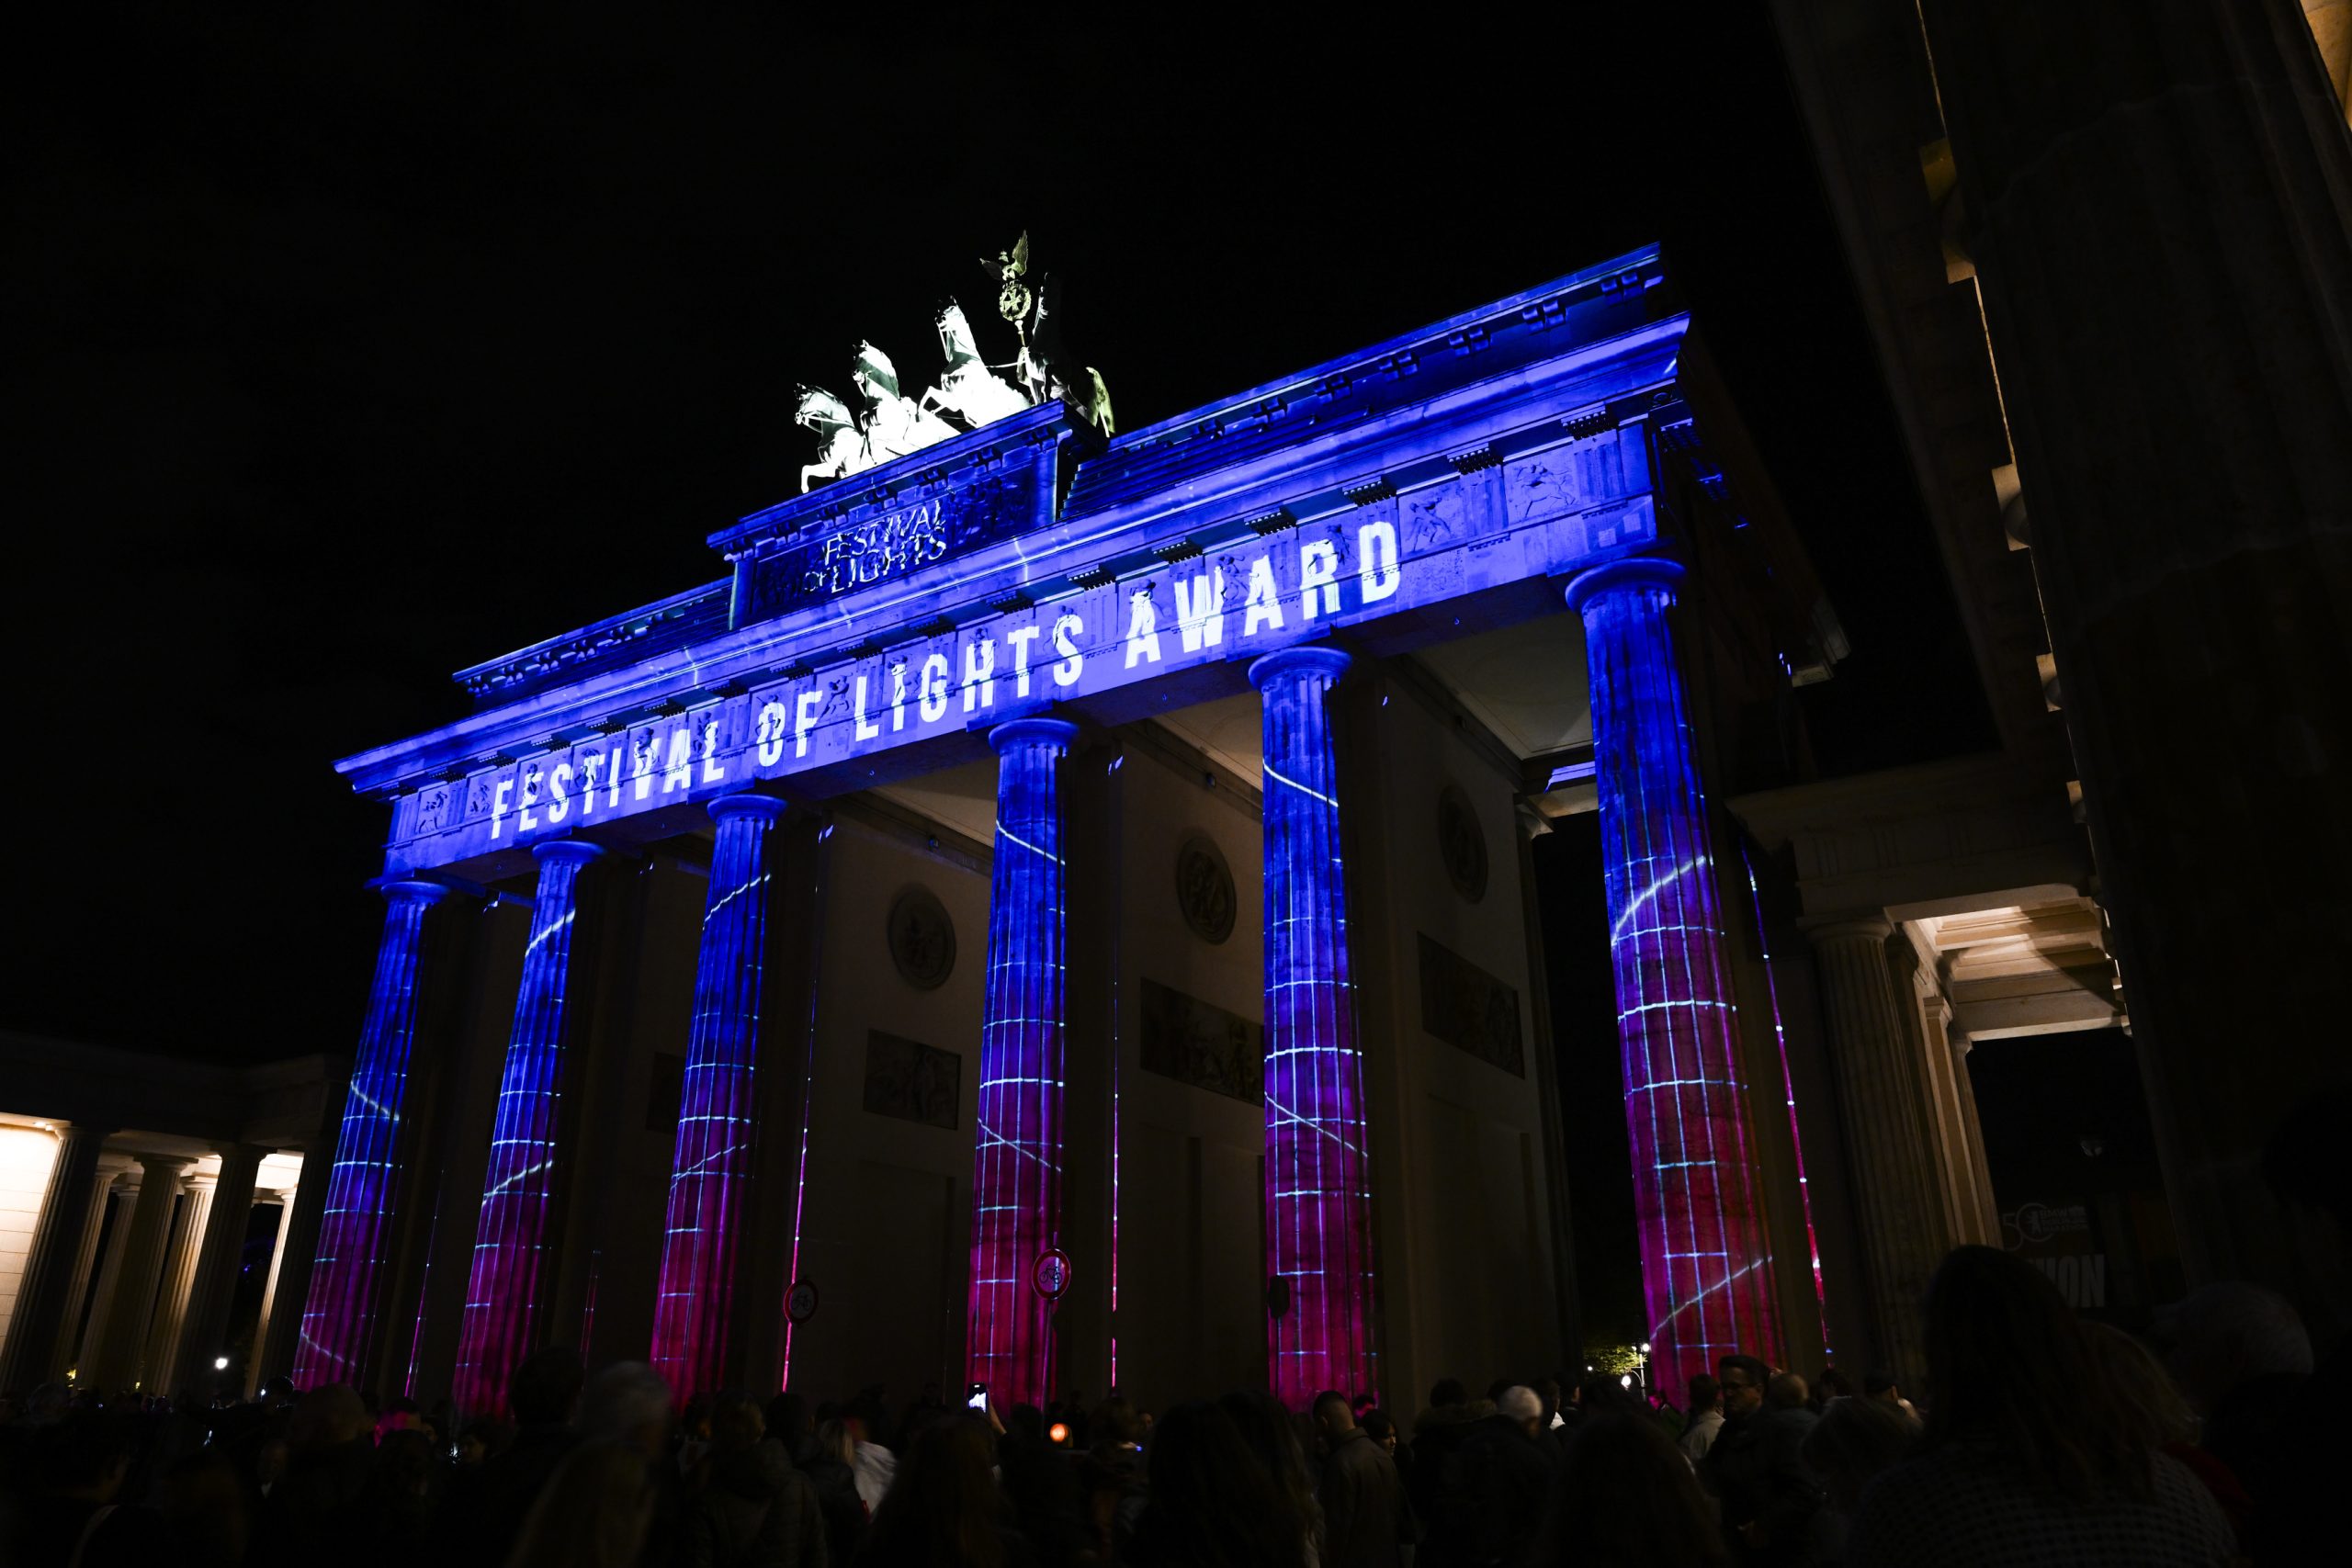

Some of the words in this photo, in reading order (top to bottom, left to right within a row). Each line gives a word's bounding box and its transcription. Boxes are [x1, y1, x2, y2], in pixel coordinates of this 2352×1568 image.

[490, 720, 725, 840] FESTIVAL
[757, 690, 823, 767] OF
[854, 614, 1084, 742] LIGHTS
[1125, 521, 1401, 670] AWARD
